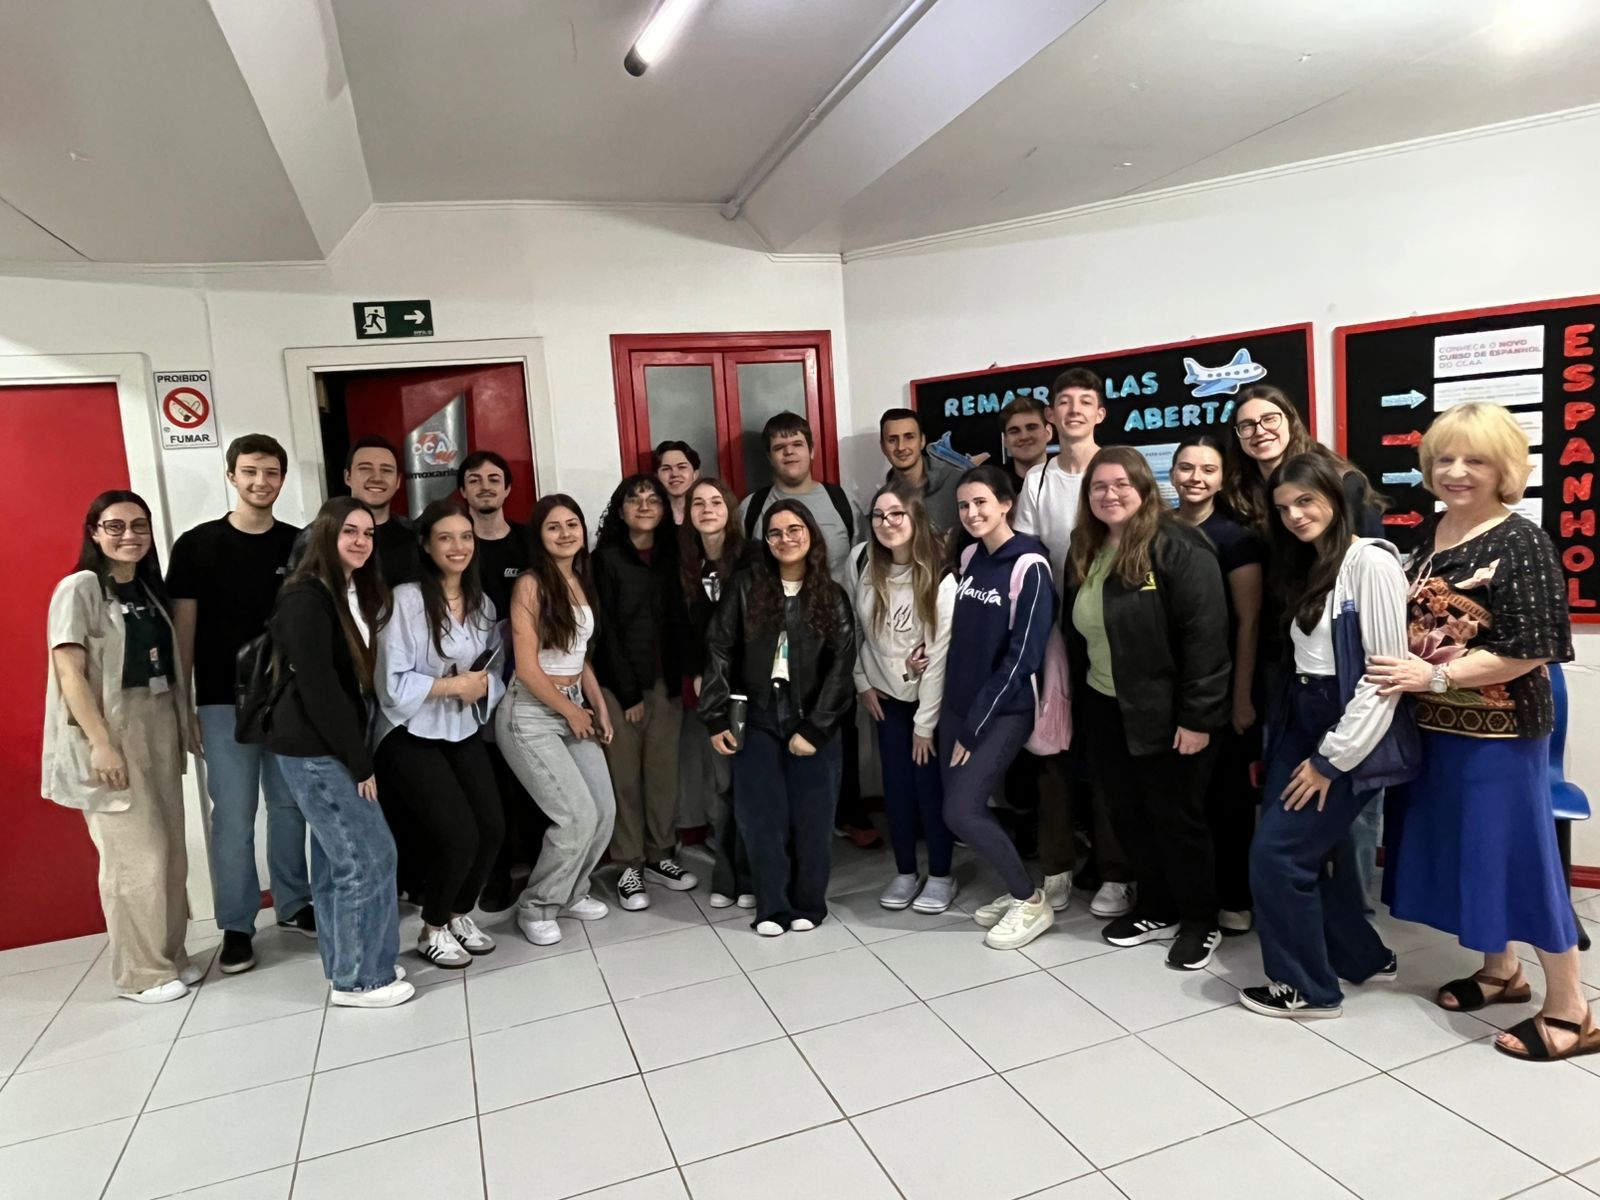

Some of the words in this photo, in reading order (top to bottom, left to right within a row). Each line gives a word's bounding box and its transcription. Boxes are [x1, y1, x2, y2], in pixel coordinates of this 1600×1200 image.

[1498, 339, 1528, 348] NOVO
[1438, 352, 1472, 361] CURSO
[1473, 350, 1488, 358] DE
[1489, 345, 1542, 357] ESPANHOL
[1438, 361, 1454, 369] DO
[156, 373, 208, 383] PROIBIDO
[169, 433, 211, 444] FUMAR
[1559, 323, 1597, 608] ESPANHOL
[956, 575, 1002, 607] Marista
